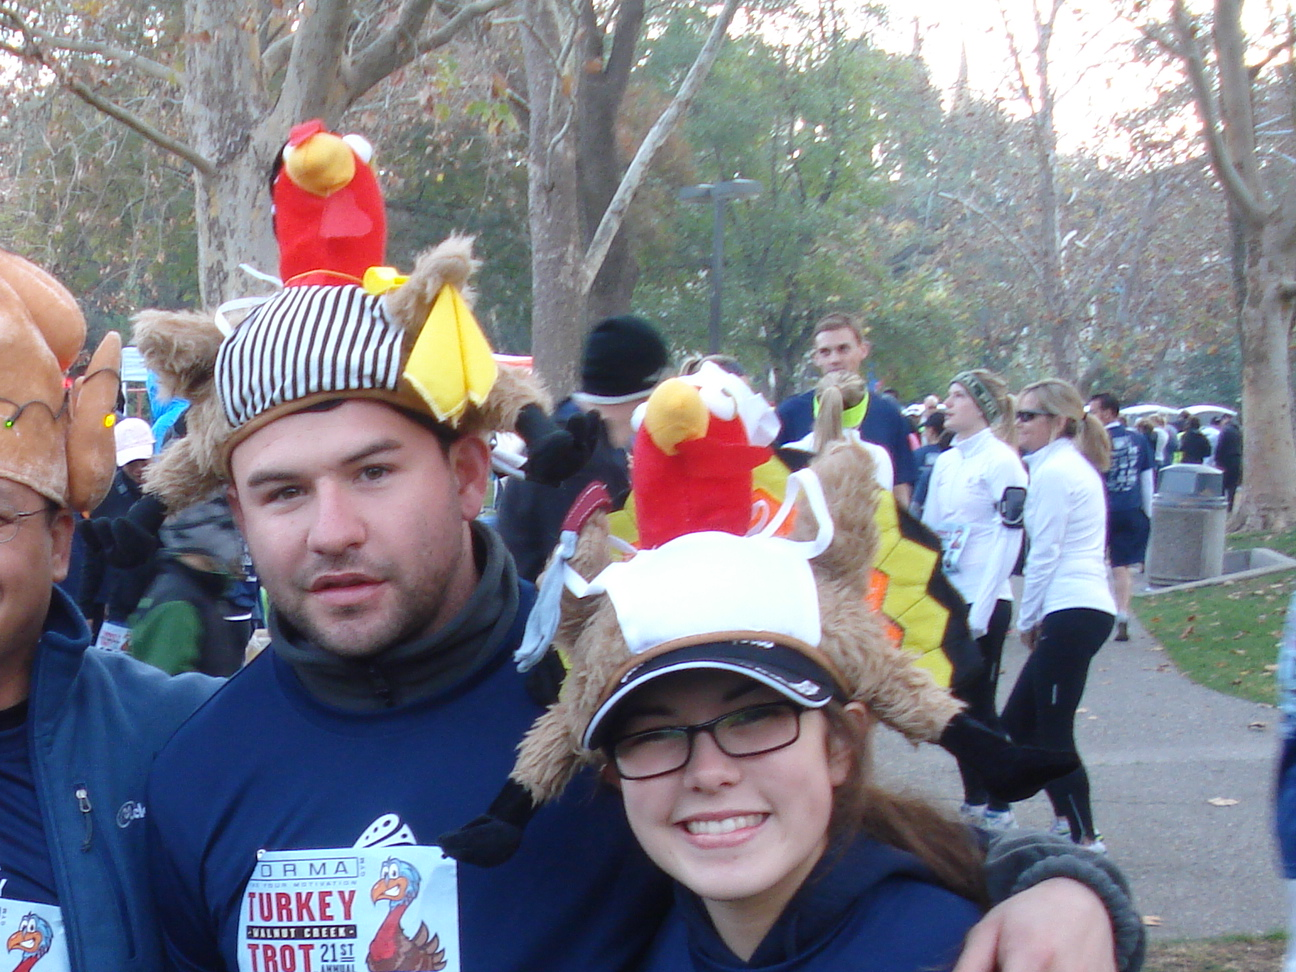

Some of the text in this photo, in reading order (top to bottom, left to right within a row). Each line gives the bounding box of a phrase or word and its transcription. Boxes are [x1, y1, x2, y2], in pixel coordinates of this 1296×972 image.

[260, 860, 349, 878] ORMA
[248, 890, 356, 923] TURKEY
[252, 926, 346, 939] WALNUT CREEK
